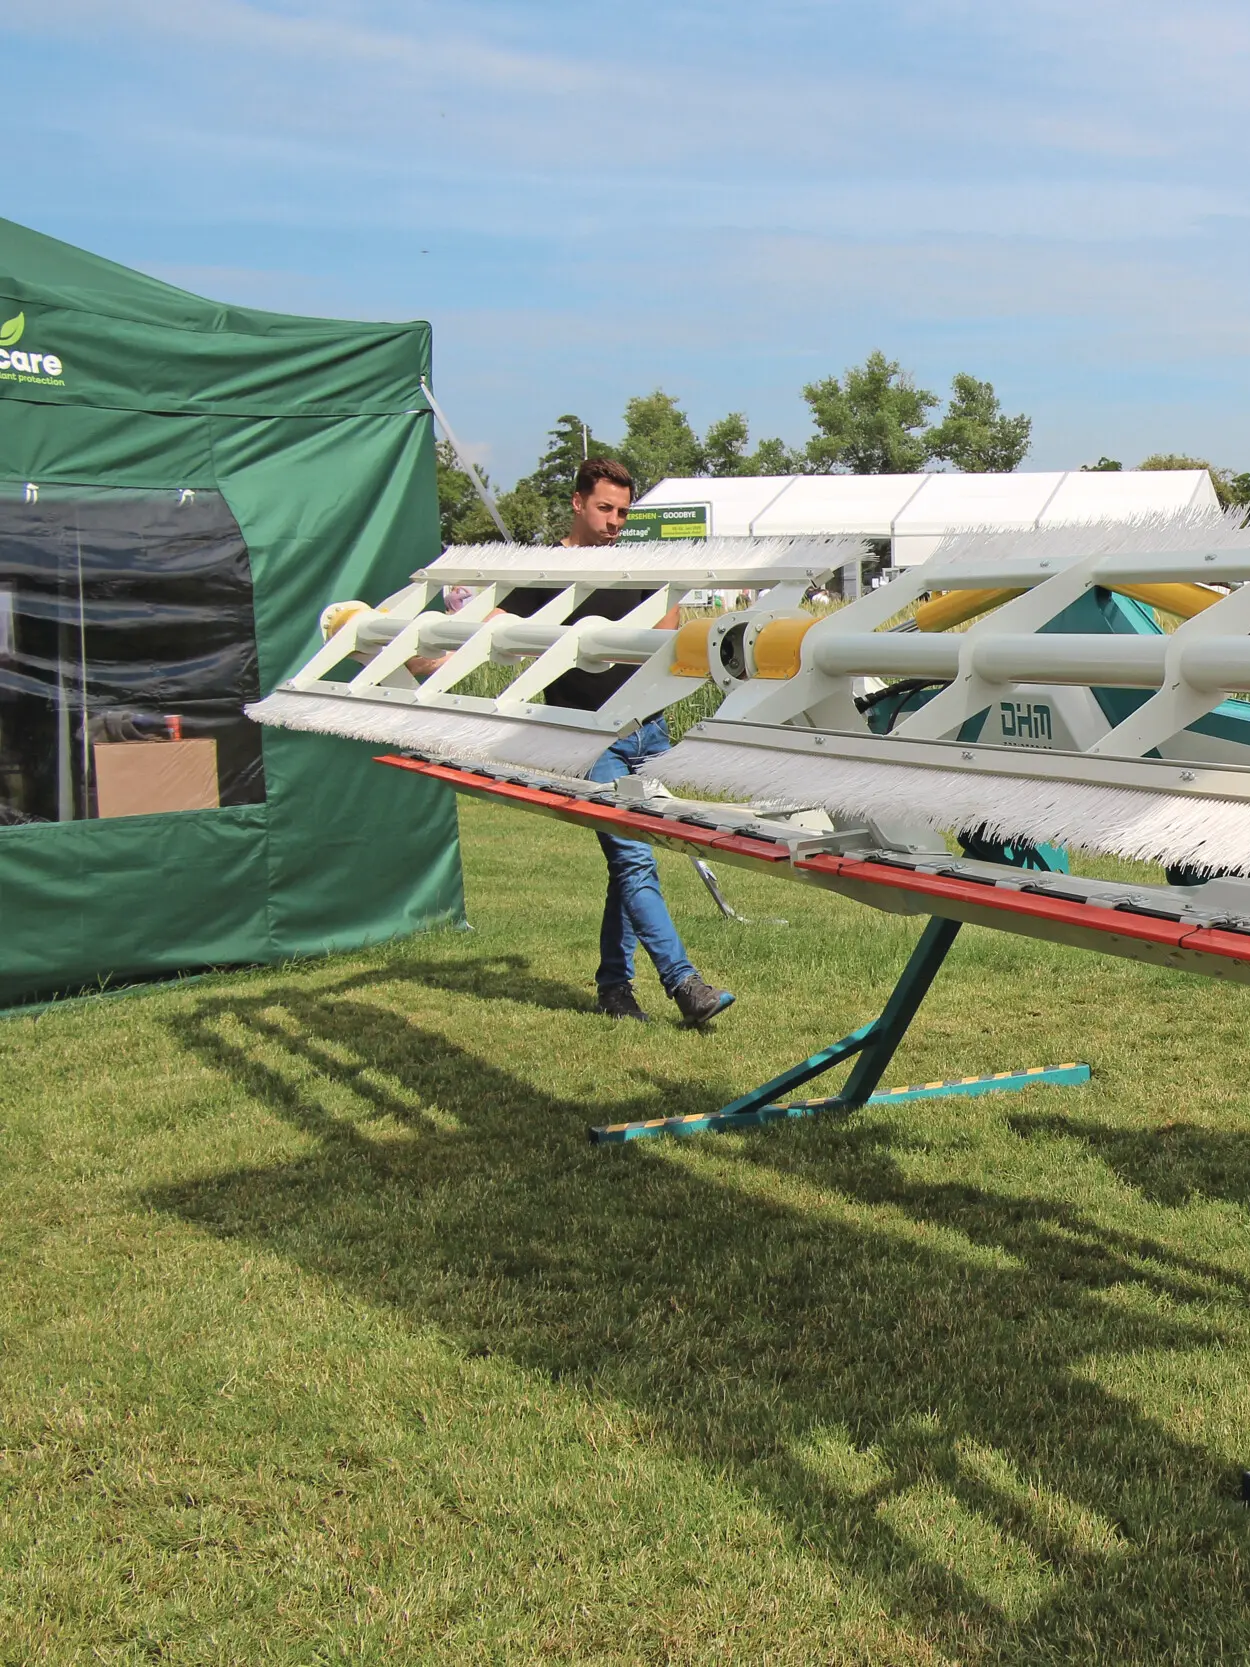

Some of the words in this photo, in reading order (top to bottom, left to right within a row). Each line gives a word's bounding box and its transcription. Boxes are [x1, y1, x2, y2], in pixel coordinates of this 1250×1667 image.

[18, 374, 66, 387] protection
[626, 512, 657, 521] ERSEHEN
[662, 511, 697, 519] GOODBYE
[1000, 702, 1053, 740] DHM
